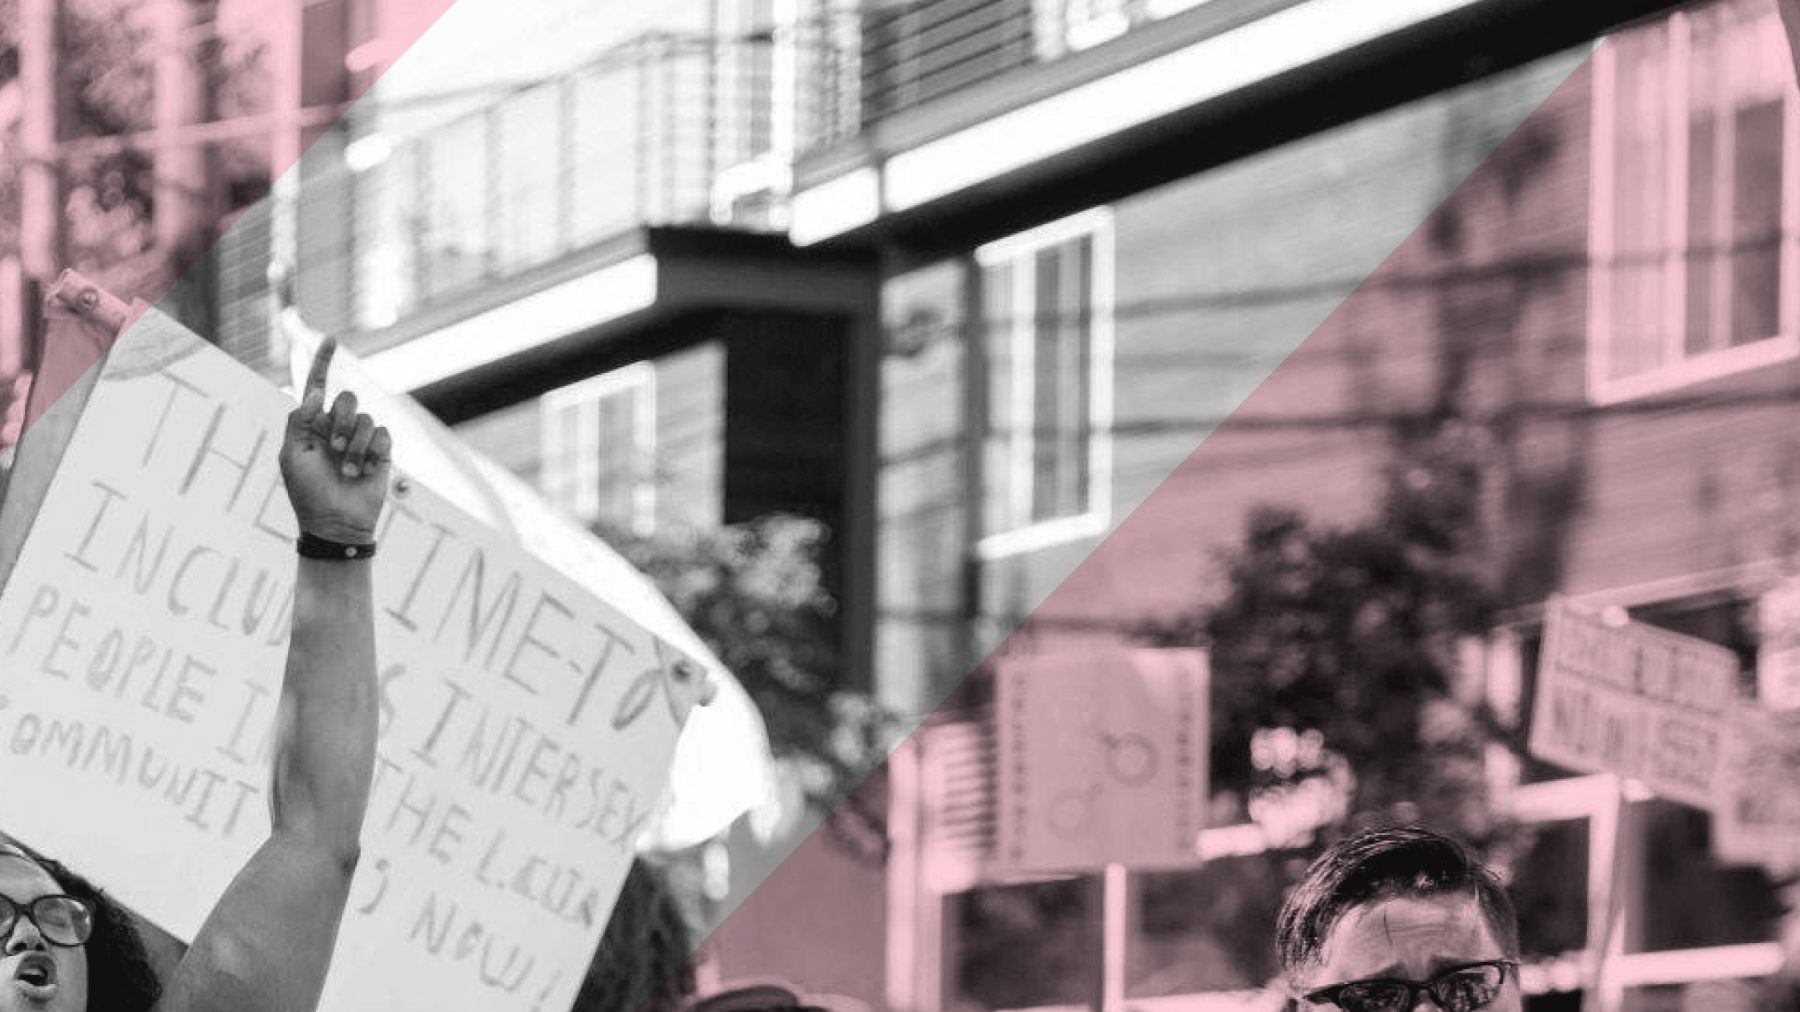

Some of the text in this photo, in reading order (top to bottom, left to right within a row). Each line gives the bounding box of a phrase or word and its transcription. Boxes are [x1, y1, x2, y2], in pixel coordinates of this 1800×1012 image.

[9, 584, 218, 724] PEOPLE
[63, 481, 295, 646] INCLUD
[408, 676, 650, 854] INTERSEX
